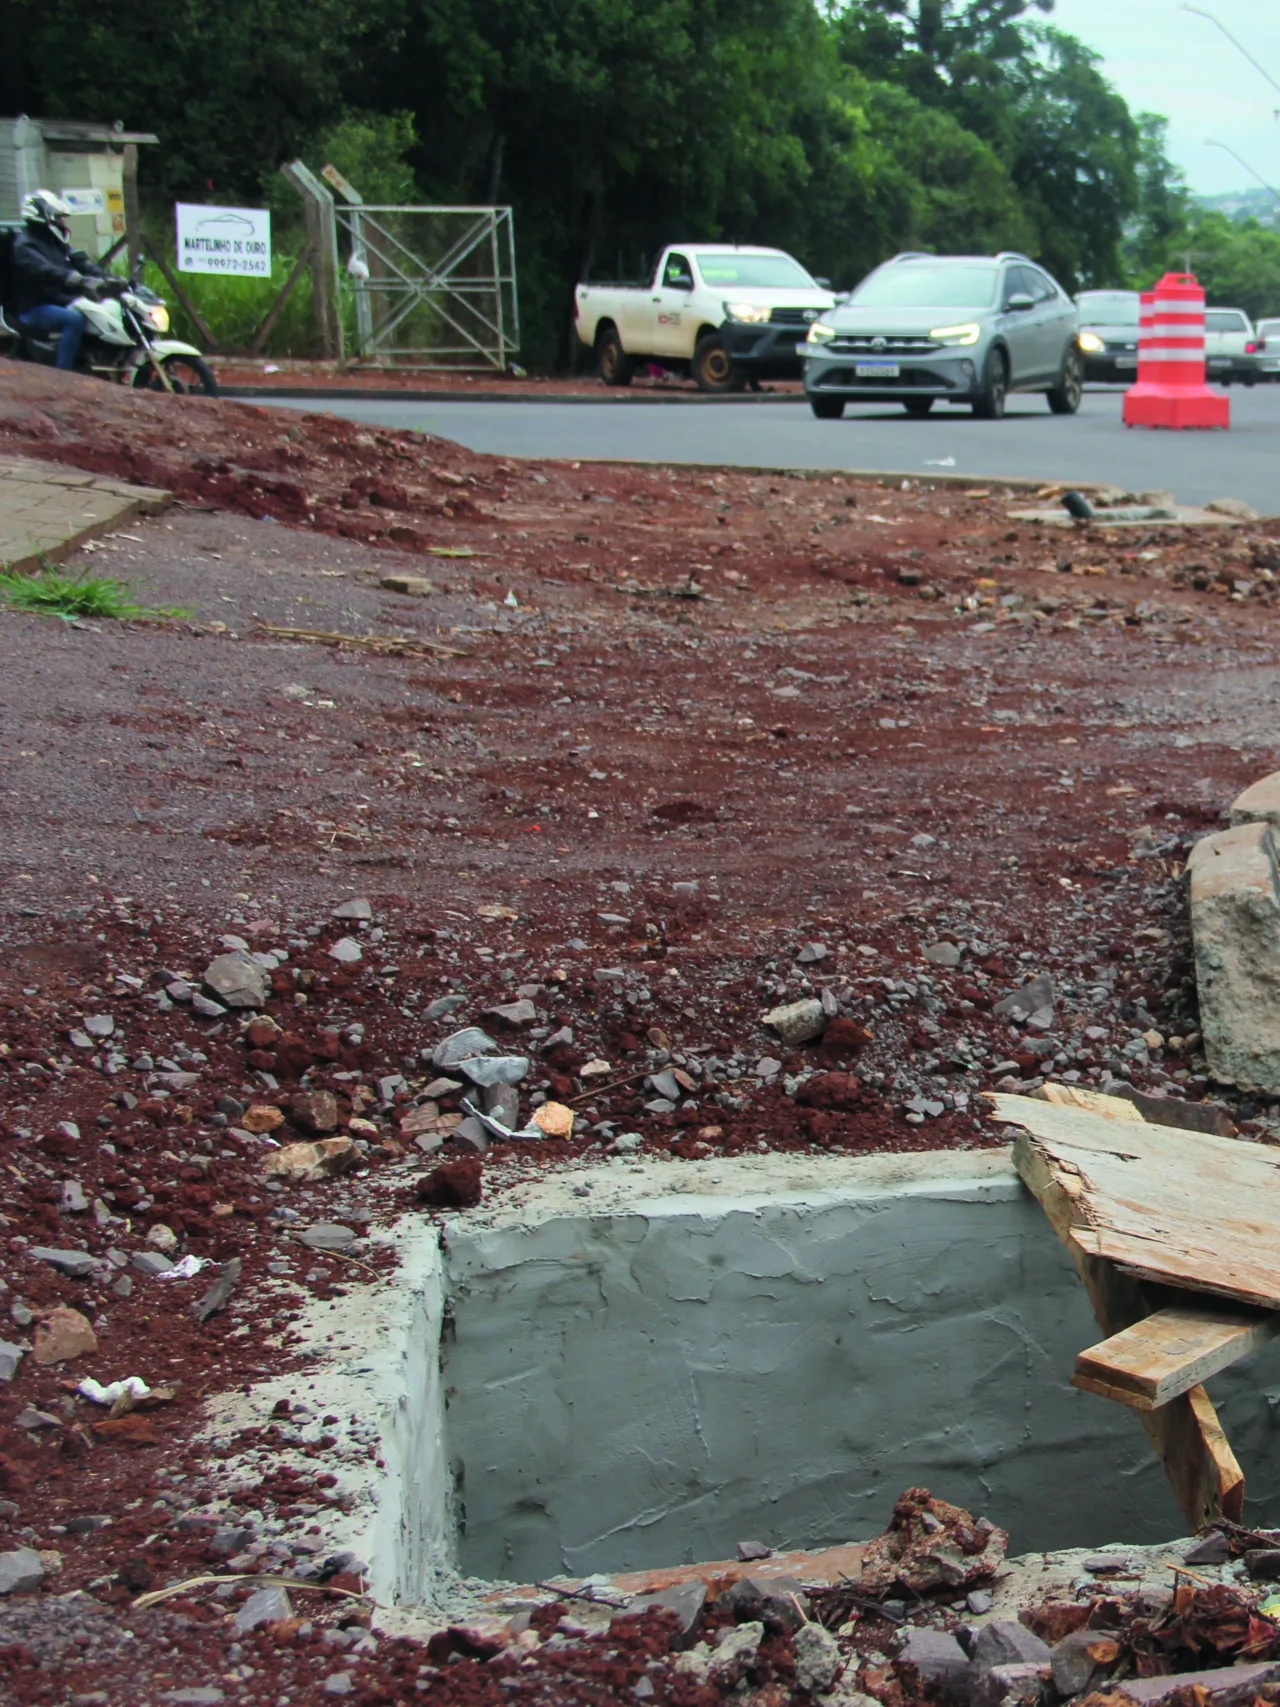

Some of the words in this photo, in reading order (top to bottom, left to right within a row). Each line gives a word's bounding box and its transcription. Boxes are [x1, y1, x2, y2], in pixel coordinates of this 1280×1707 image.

[185, 238, 231, 252] MARTELINHO
[234, 241, 243, 253] DE
[246, 242, 266, 255] OURO
